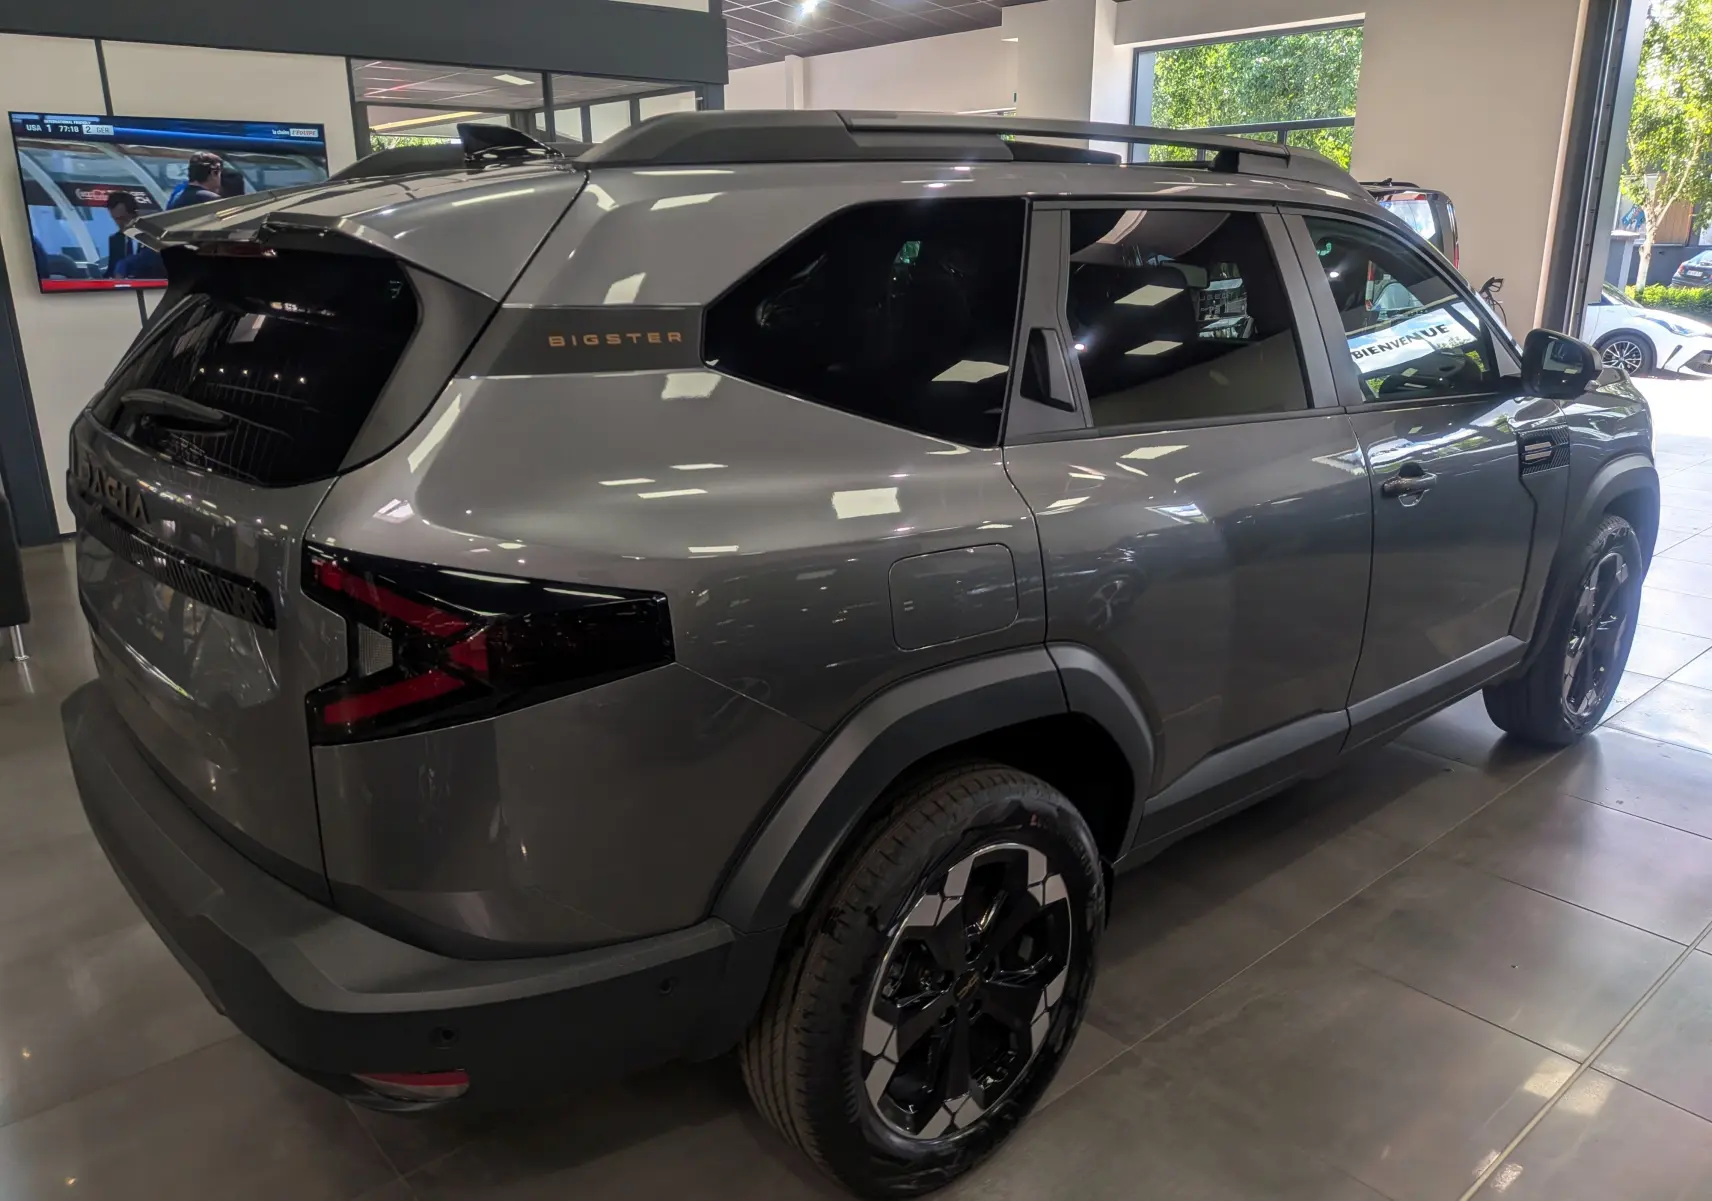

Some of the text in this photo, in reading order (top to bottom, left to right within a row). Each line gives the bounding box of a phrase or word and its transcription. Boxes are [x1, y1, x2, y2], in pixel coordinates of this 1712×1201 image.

[25, 123, 42, 132] USA
[46, 124, 52, 133] 1
[58, 125, 80, 133] 77:18
[85, 125, 92, 134] 2
[549, 332, 682, 347] BIGSTER
[1351, 323, 1450, 360] BIENVENUE
